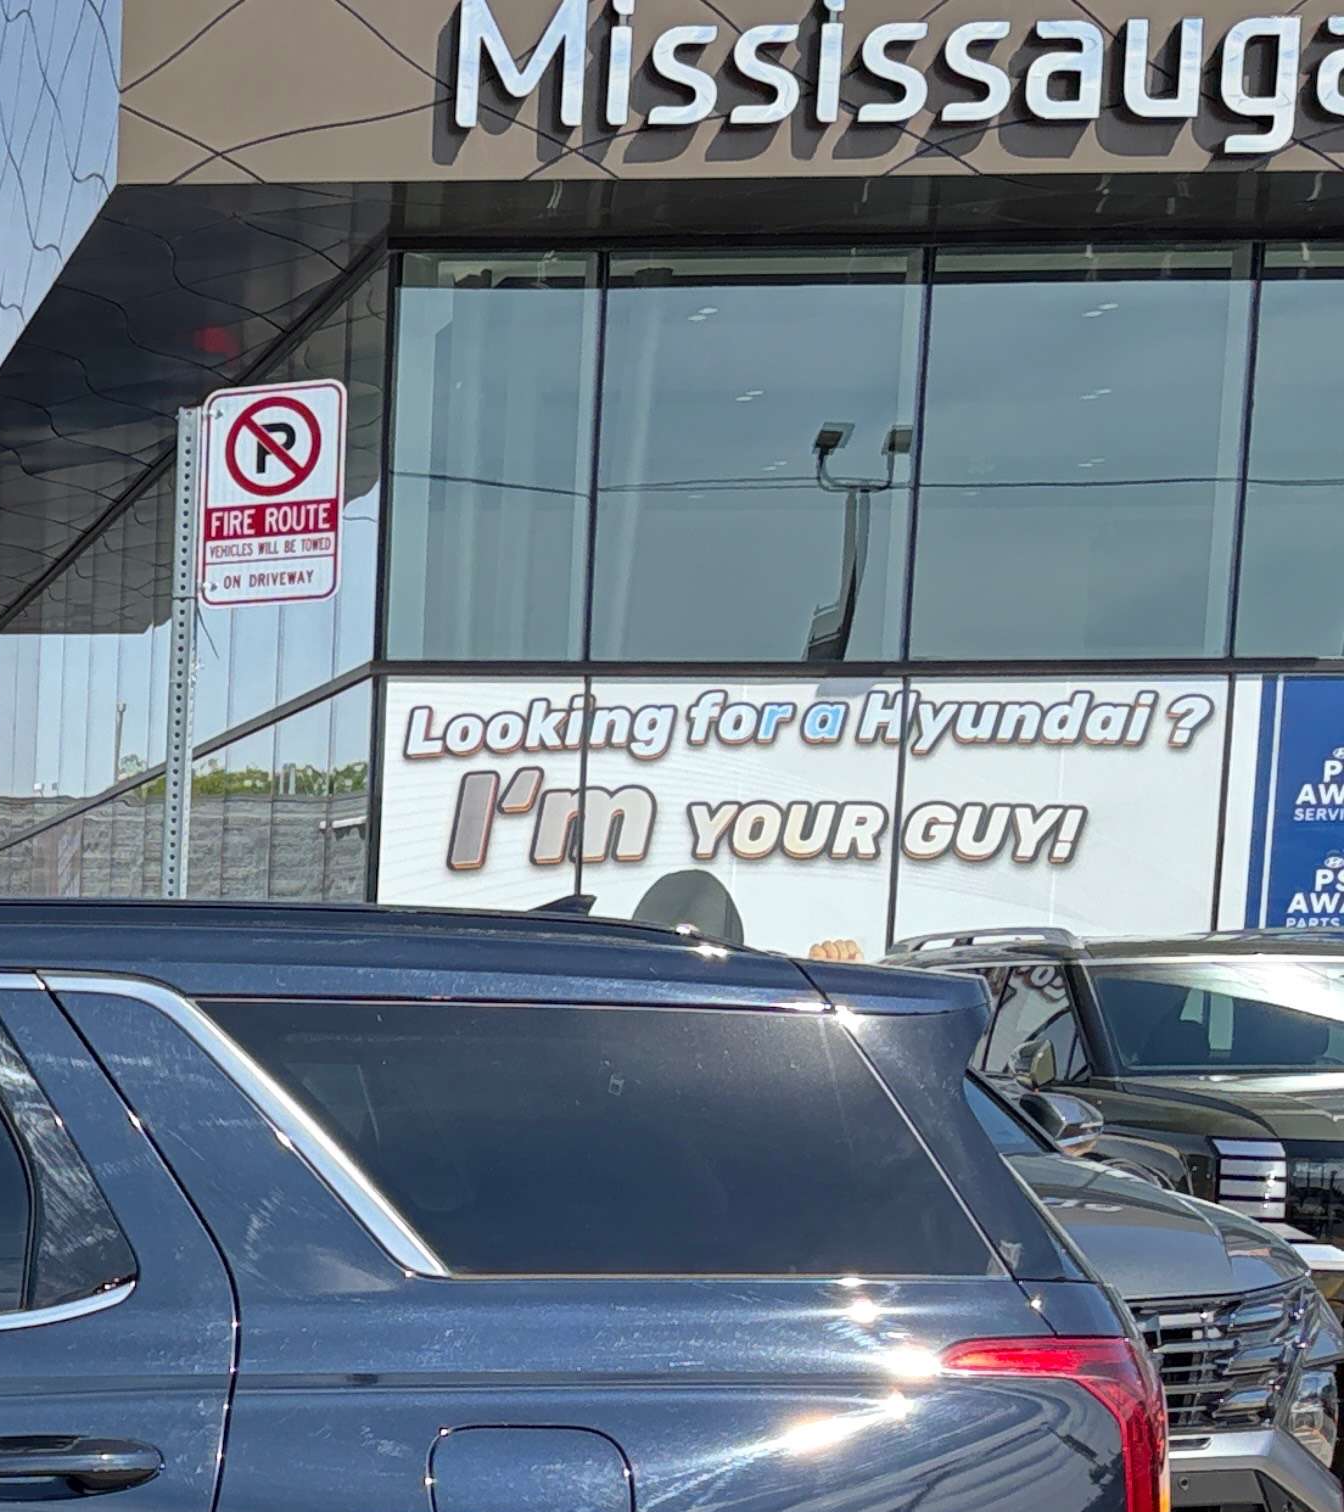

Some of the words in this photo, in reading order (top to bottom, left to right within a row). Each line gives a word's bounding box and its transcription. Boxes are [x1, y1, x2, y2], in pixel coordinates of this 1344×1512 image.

[210, 508, 256, 538] FIRE
[264, 503, 331, 533] ROUTE
[209, 545, 254, 559] VEHICLES
[258, 540, 279, 555] WILL
[283, 538, 296, 554] BE
[300, 536, 331, 552] TOWED
[223, 574, 241, 590] ON
[248, 569, 314, 588] DRIVEWAY
[403, 692, 678, 762] Looking
[686, 689, 794, 745] for
[800, 701, 848, 745] a
[855, 690, 1159, 756] Hyundai
[446, 766, 657, 871] I'm
[686, 800, 889, 862] YOUR
[901, 800, 1088, 864] GUY!
[1286, 892, 1344, 914] AW
[1286, 917, 1341, 928] PARTS
